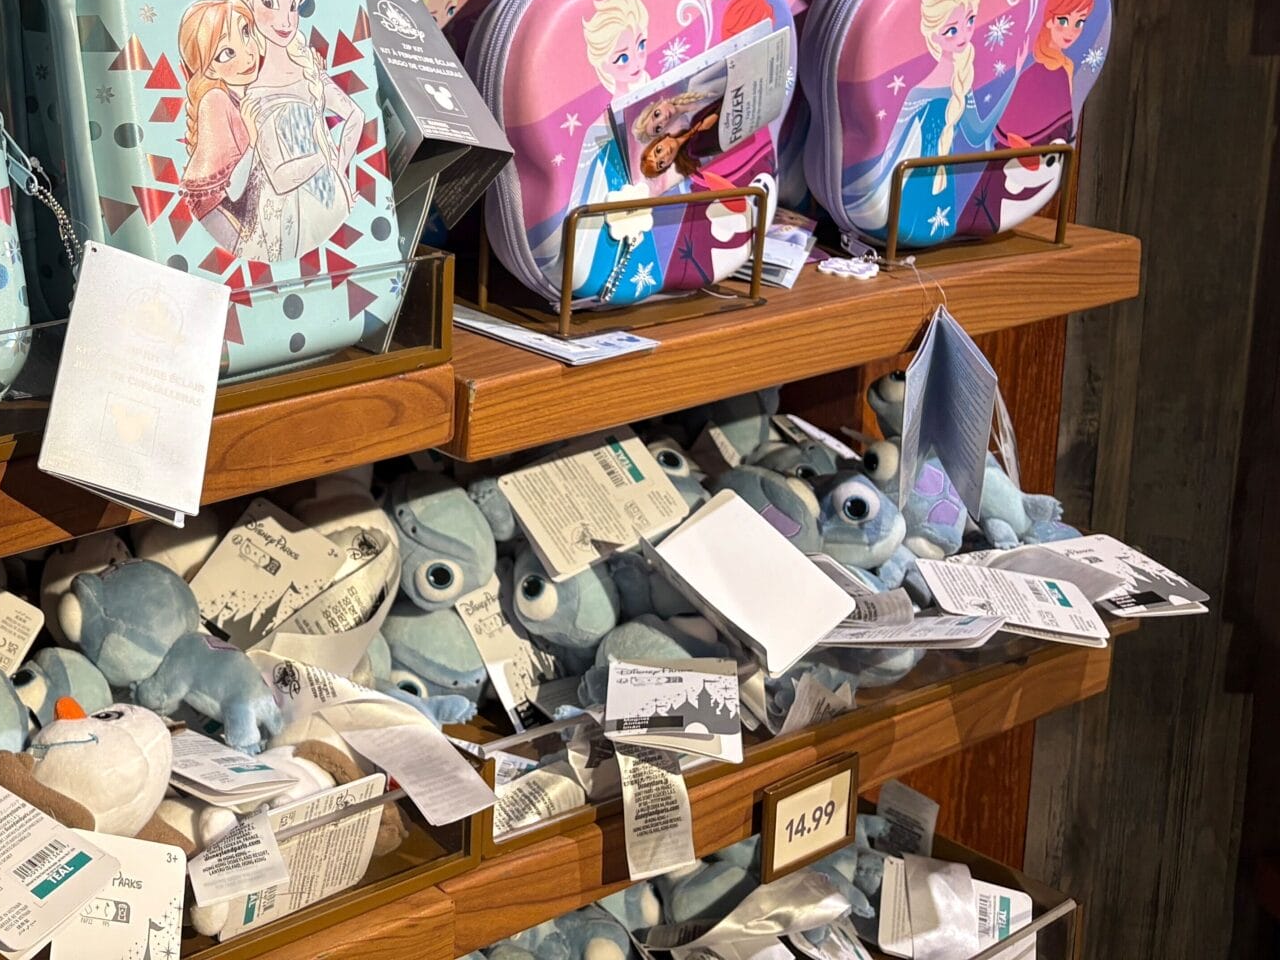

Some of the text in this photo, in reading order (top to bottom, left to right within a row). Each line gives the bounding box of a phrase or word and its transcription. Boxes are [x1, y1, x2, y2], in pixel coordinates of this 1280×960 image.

[729, 84, 744, 144] FROZEN
[785, 800, 835, 842] 14.99
[166, 852, 178, 863] 3+
[203, 838, 261, 861] disneylandparis.com
[48, 864, 75, 884] TEAL
[999, 909, 1007, 929] TEAL
